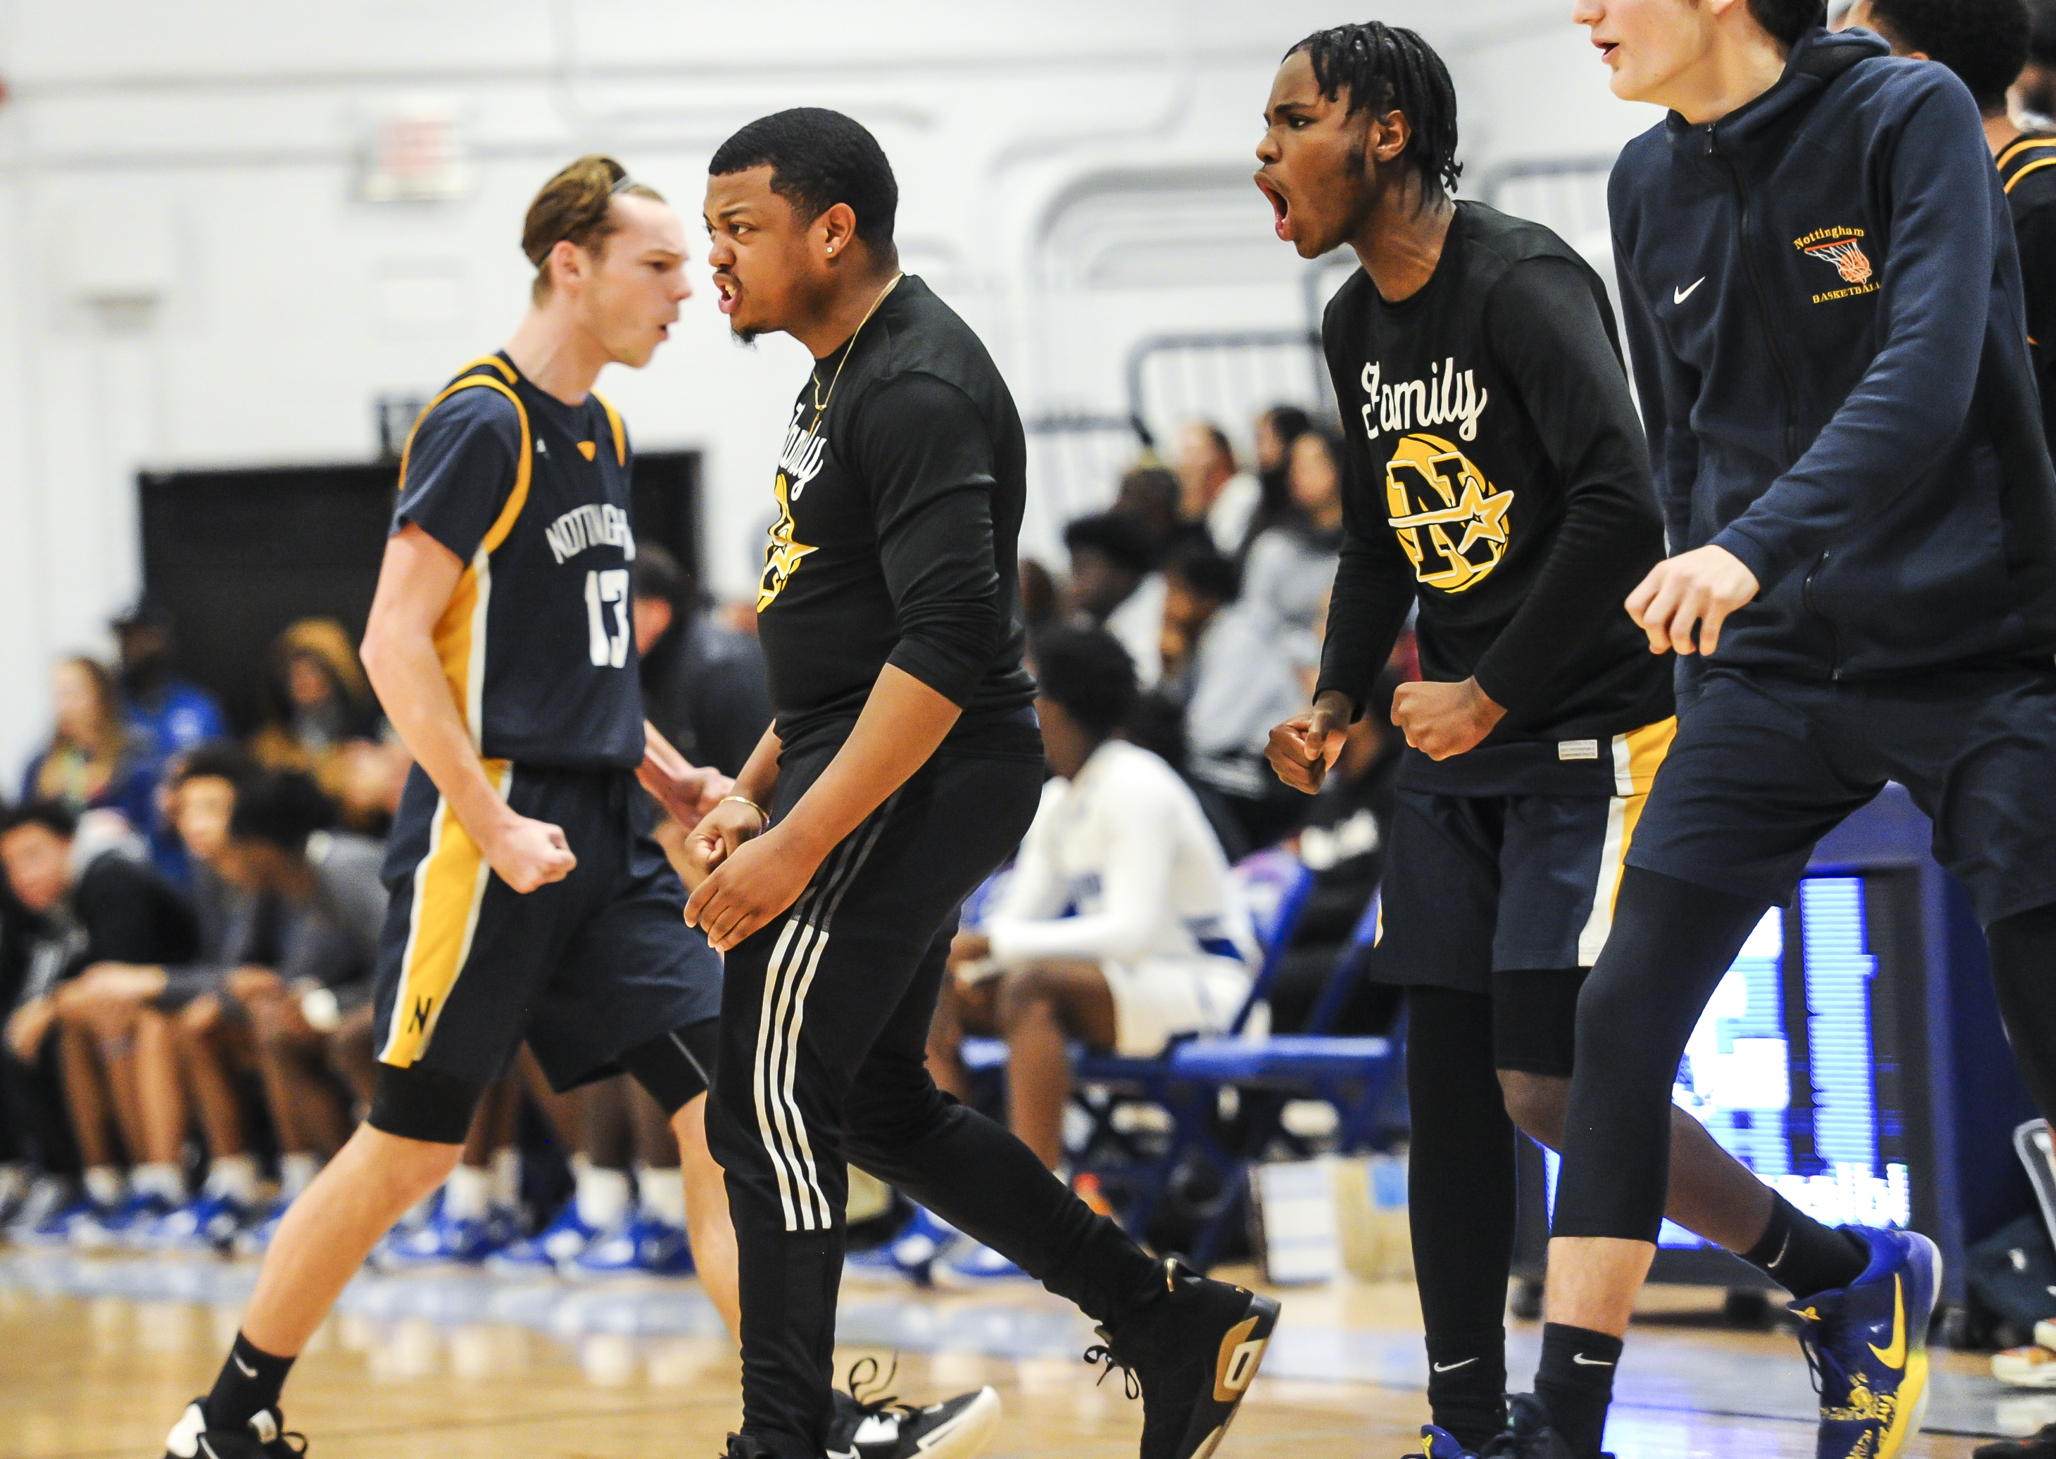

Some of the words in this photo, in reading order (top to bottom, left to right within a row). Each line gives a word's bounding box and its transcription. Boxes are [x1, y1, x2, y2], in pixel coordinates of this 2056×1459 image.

[1793, 225, 1865, 250] Nottingham
[1361, 357, 1487, 441] Family
[585, 569, 630, 668] 13
[408, 995, 432, 1034] N
